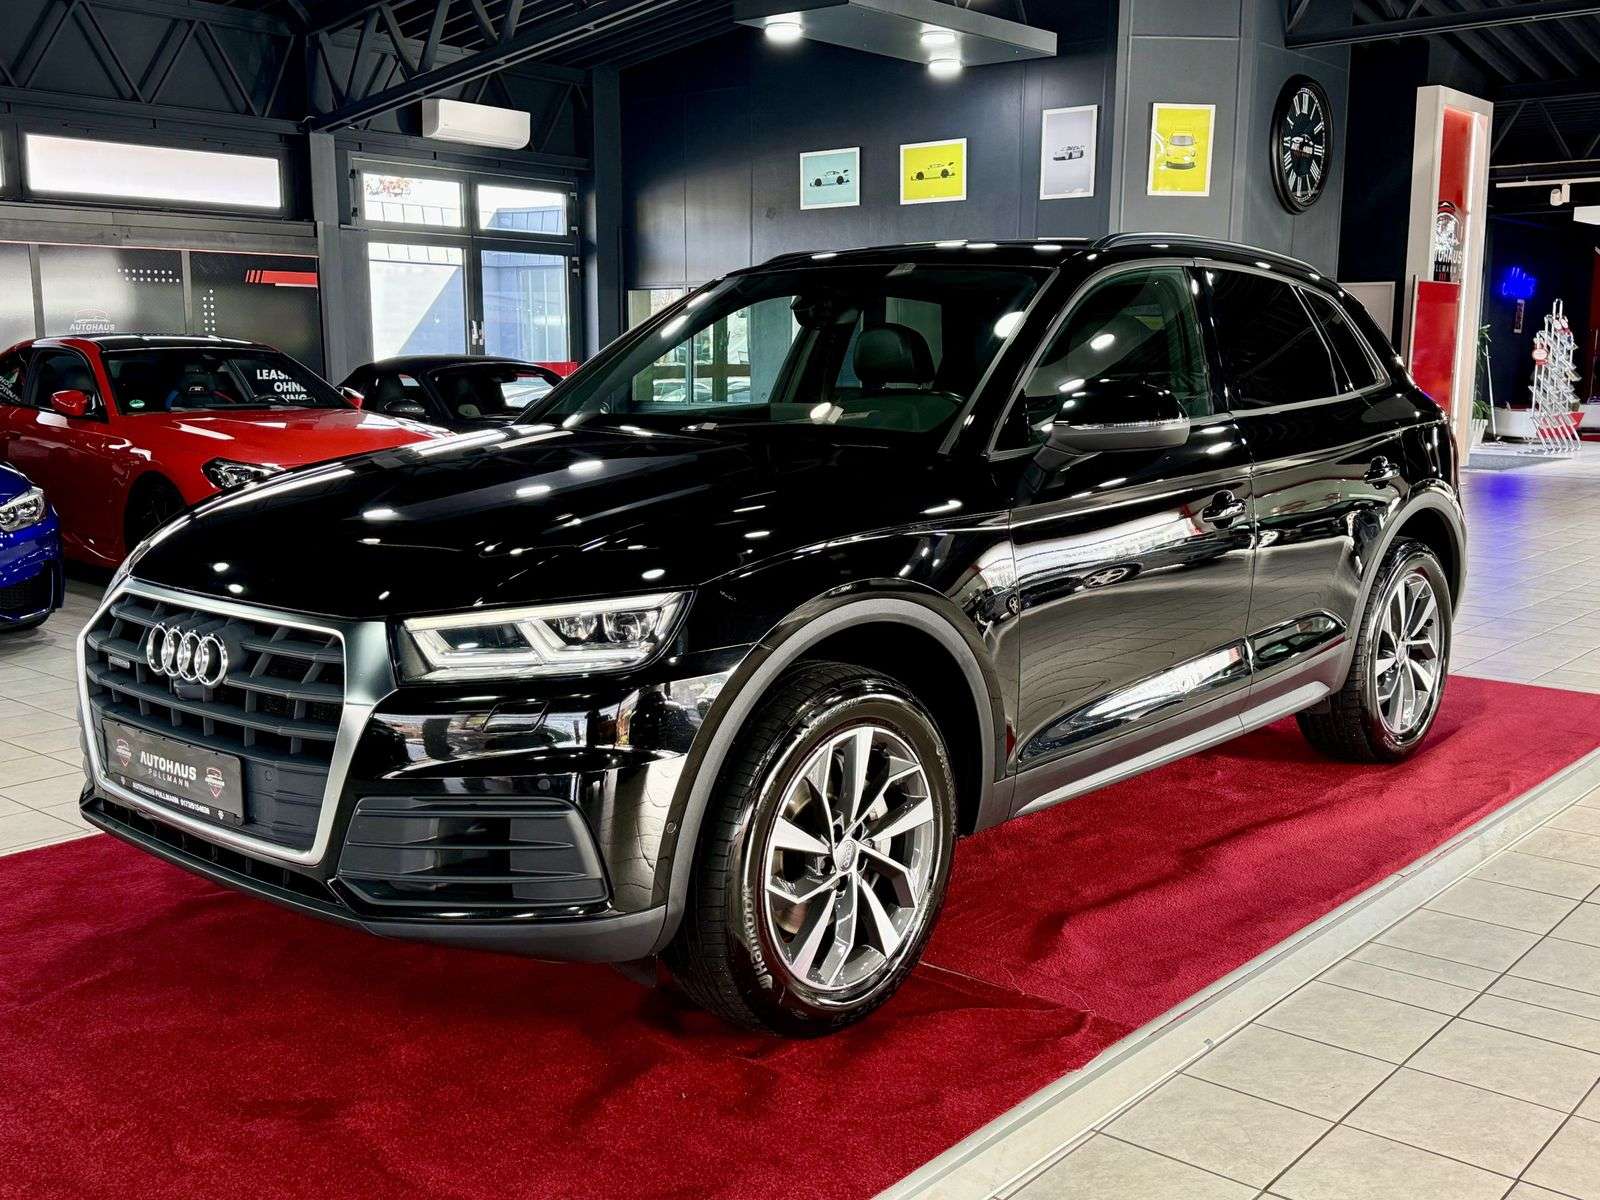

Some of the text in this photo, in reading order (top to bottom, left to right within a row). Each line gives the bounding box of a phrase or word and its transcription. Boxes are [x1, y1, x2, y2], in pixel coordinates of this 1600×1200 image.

[69, 323, 115, 332] AUTOHAUS
[256, 369, 292, 380] LEAS
[140, 750, 197, 781] AUTOHAUS
[148, 767, 190, 788] PULLMANN
